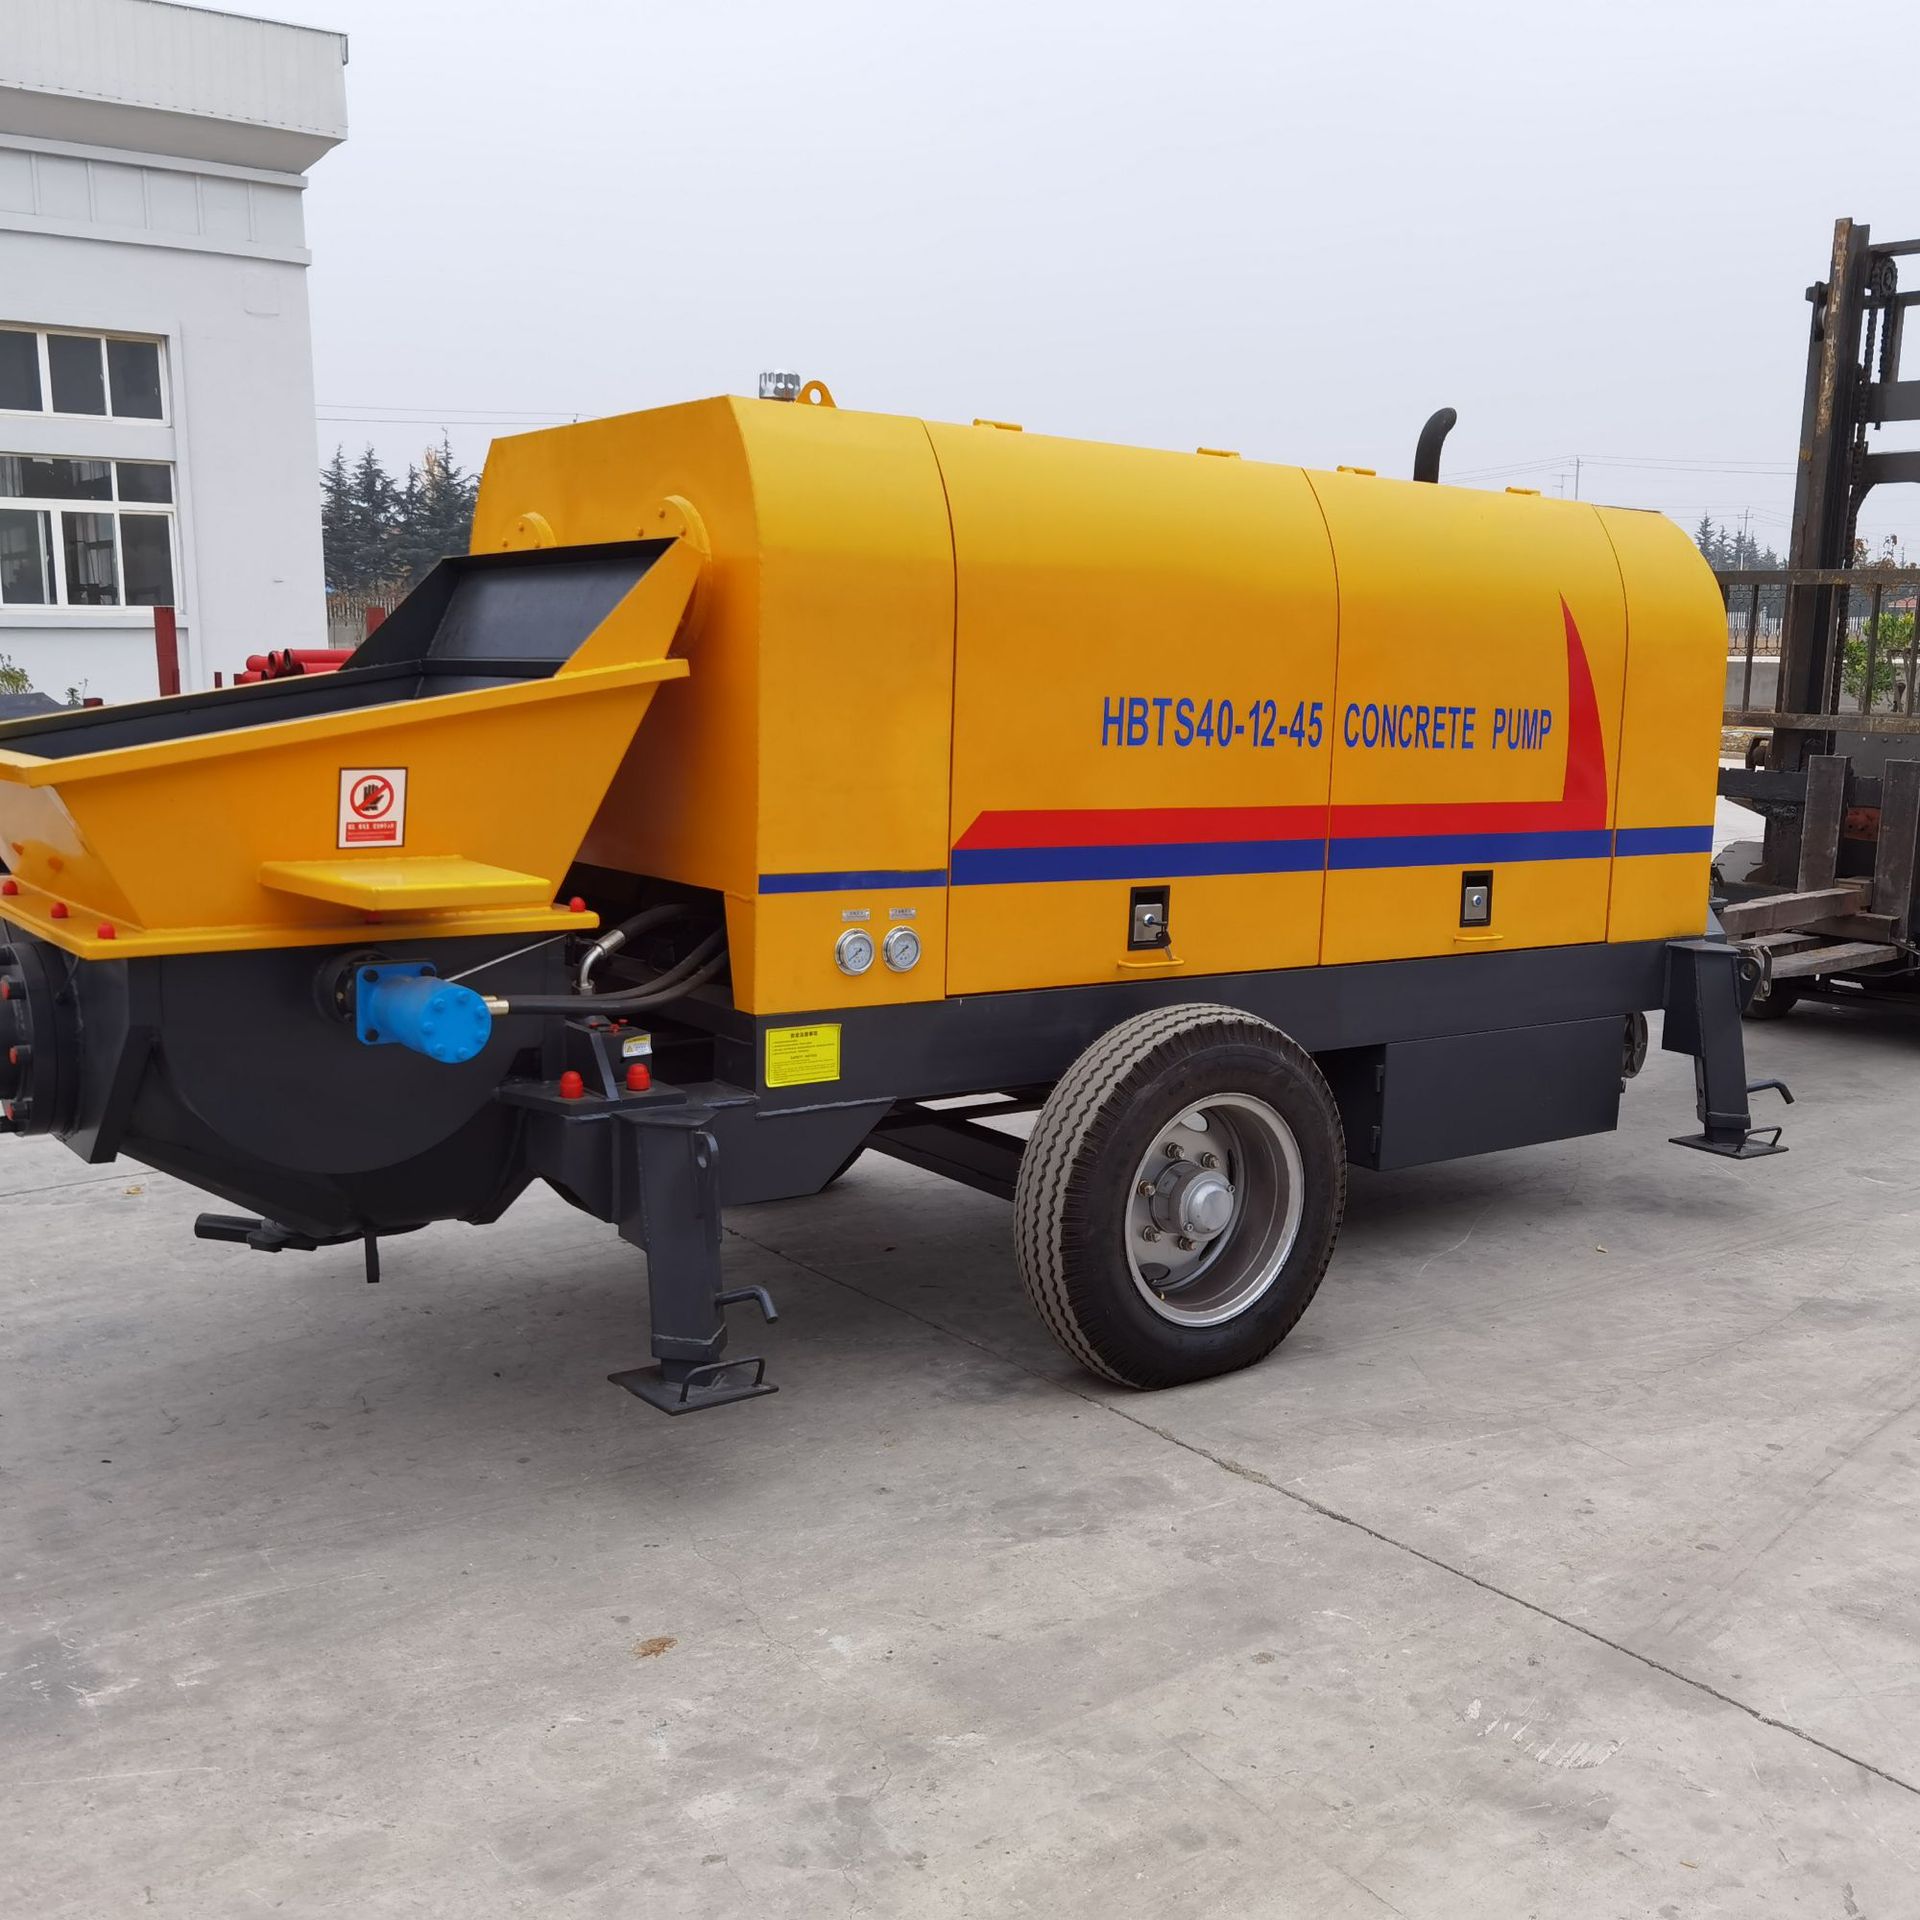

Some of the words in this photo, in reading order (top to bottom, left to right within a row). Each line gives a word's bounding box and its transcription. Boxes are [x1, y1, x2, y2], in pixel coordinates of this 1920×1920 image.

[1102, 697, 1323, 747] HBTS40-12-45
[1345, 703, 1476, 749] CONCRETE
[1493, 708, 1551, 750] PUMP
